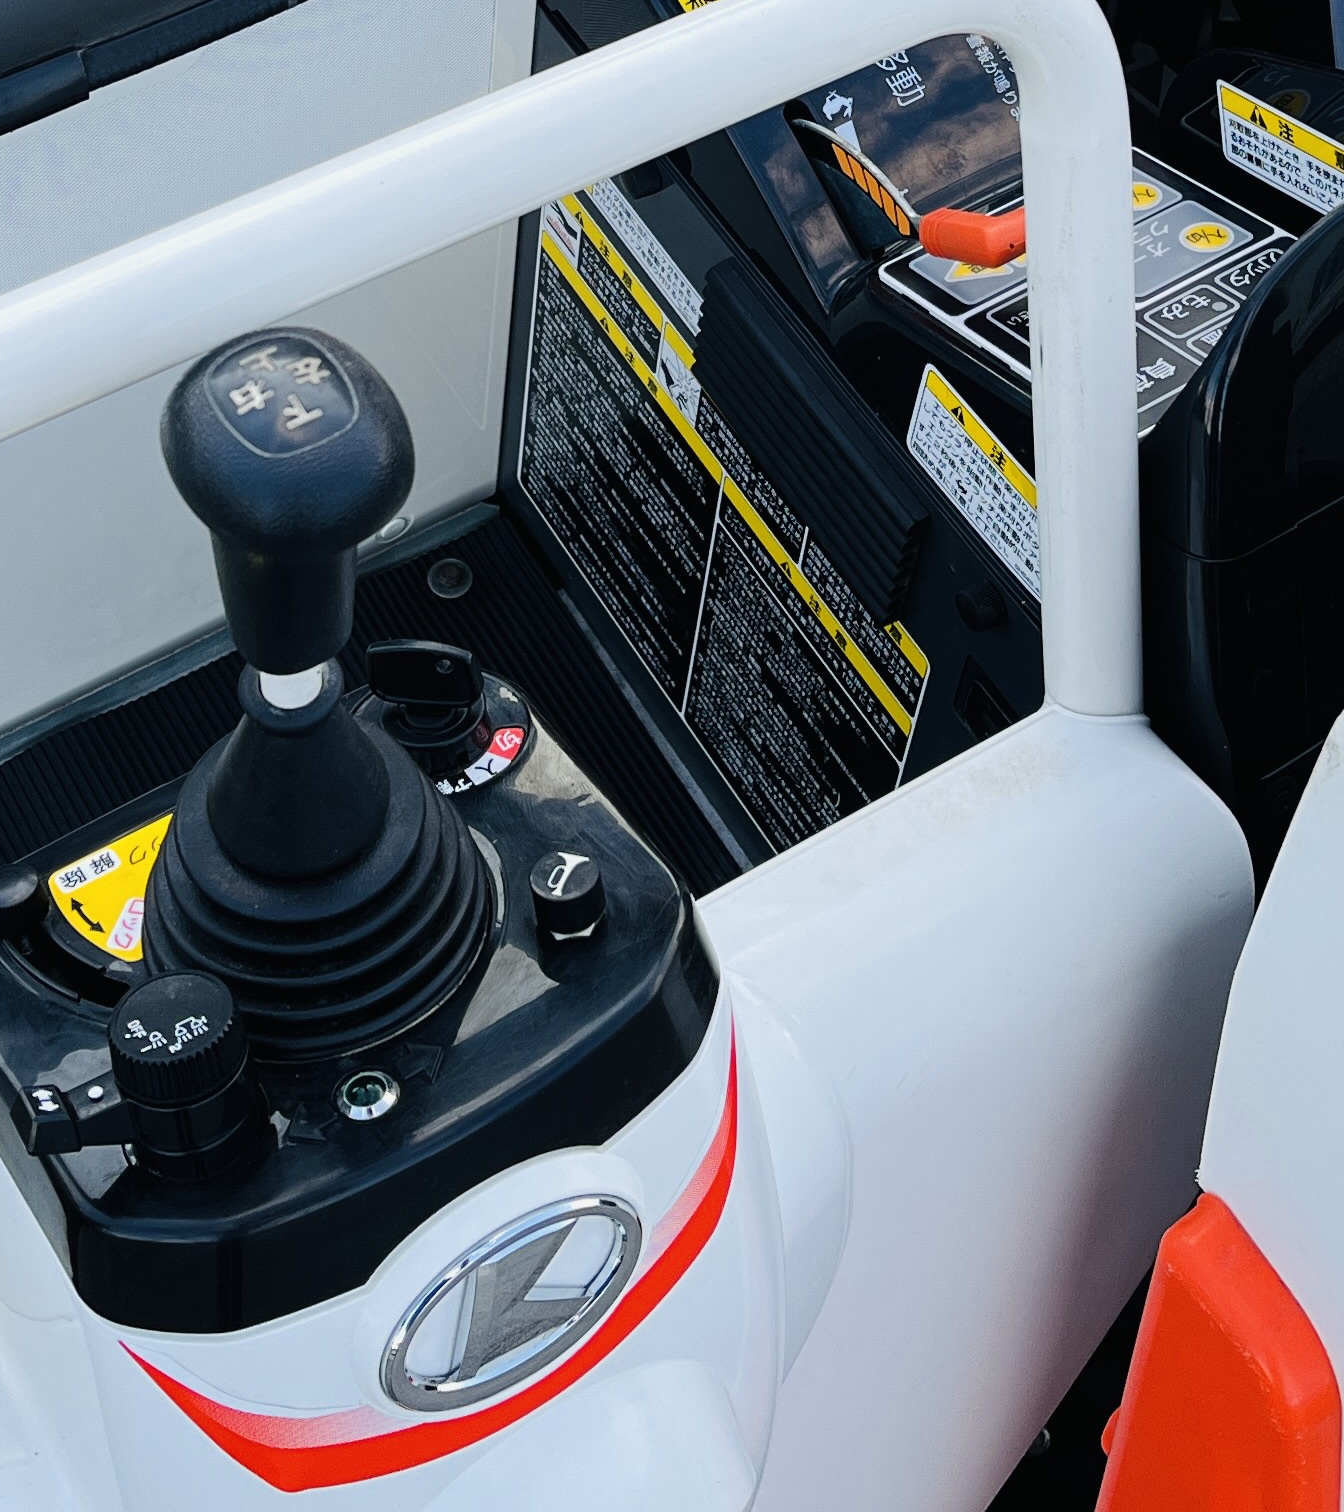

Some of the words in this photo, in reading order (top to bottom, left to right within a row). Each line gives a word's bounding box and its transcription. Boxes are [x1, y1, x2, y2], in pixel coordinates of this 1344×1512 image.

[1185, 228, 1227, 244] 入/切
[1160, 293, 1212, 321] もみ
[239, 346, 278, 373] 上
[228, 378, 276, 416] 右
[282, 393, 324, 430] 下
[474, 758, 498, 776] 入
[60, 851, 115, 888] 解除
[114, 899, 145, 949] ロック
[127, 1019, 148, 1039] OFF
